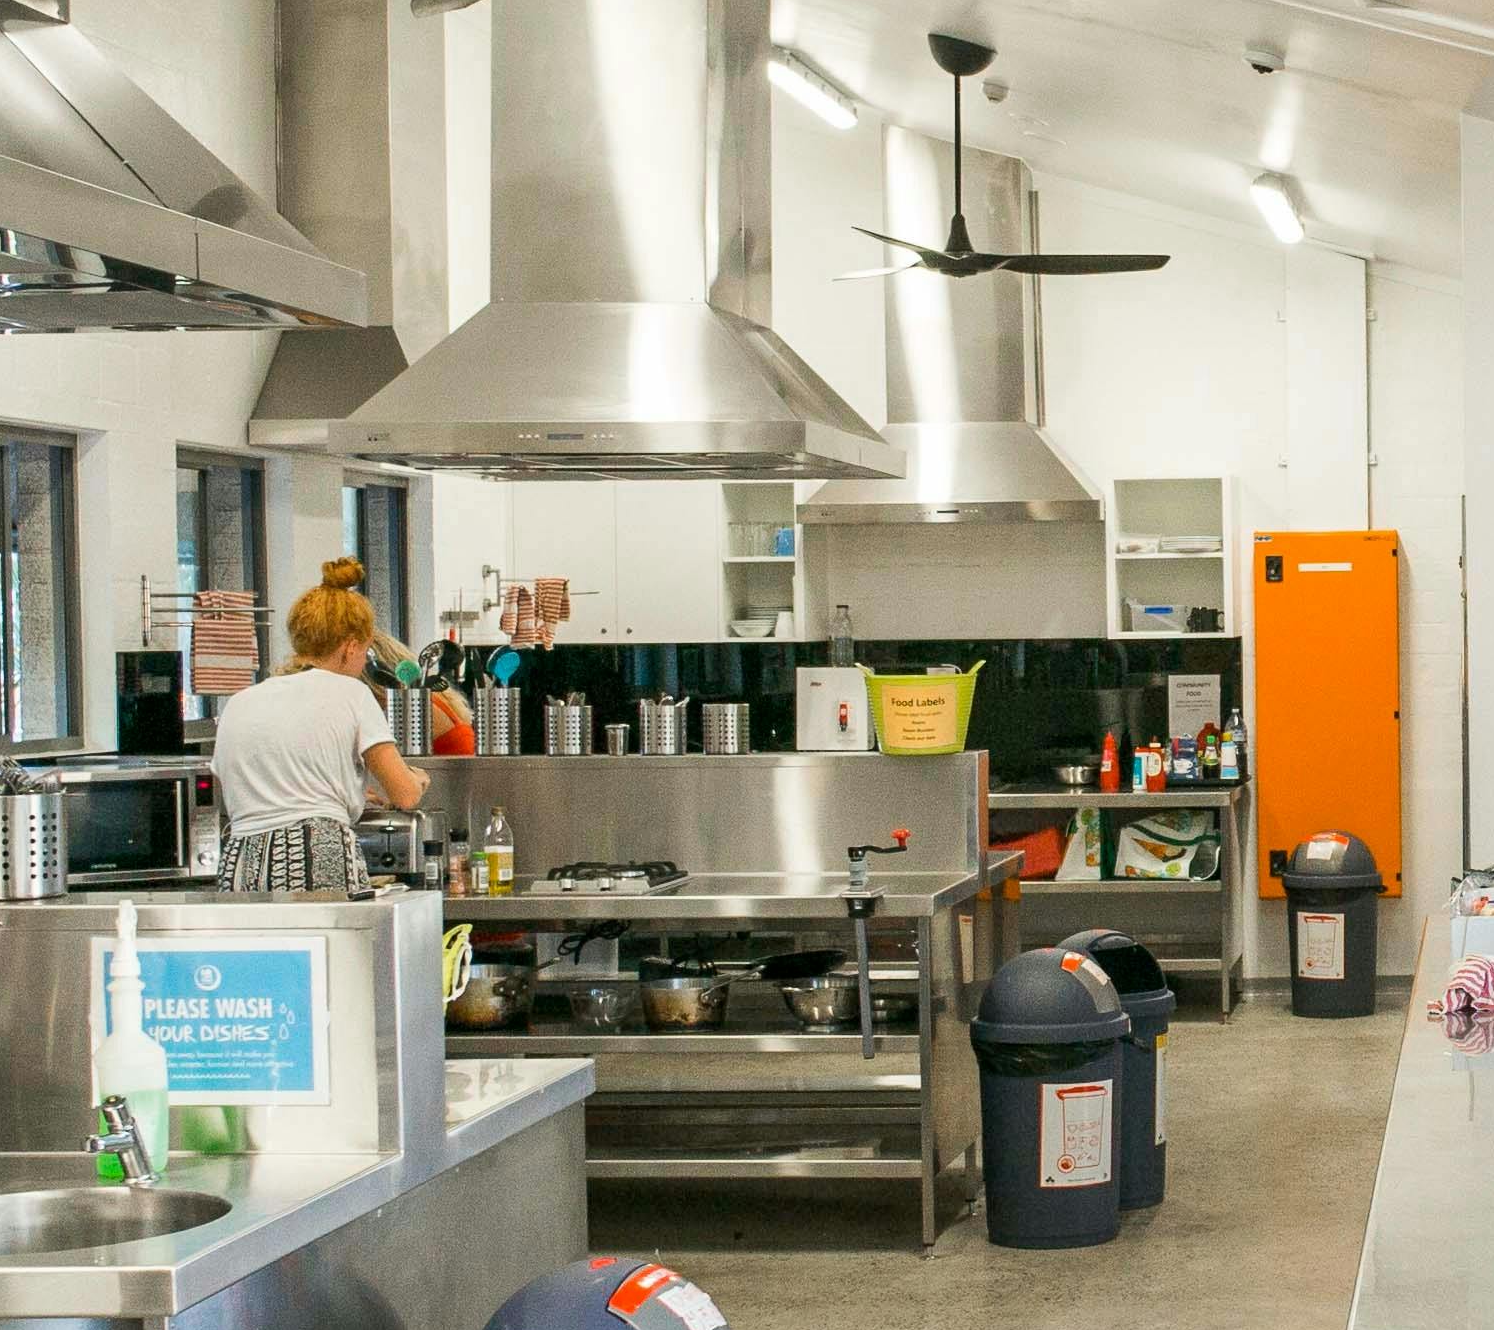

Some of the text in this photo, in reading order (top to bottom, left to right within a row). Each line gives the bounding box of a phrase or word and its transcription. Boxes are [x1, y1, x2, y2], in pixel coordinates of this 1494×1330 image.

[891, 695, 945, 707] Food Labels
[144, 998, 273, 1019] PLEASE WASH
[148, 1023, 270, 1043] YOUR DISHES
